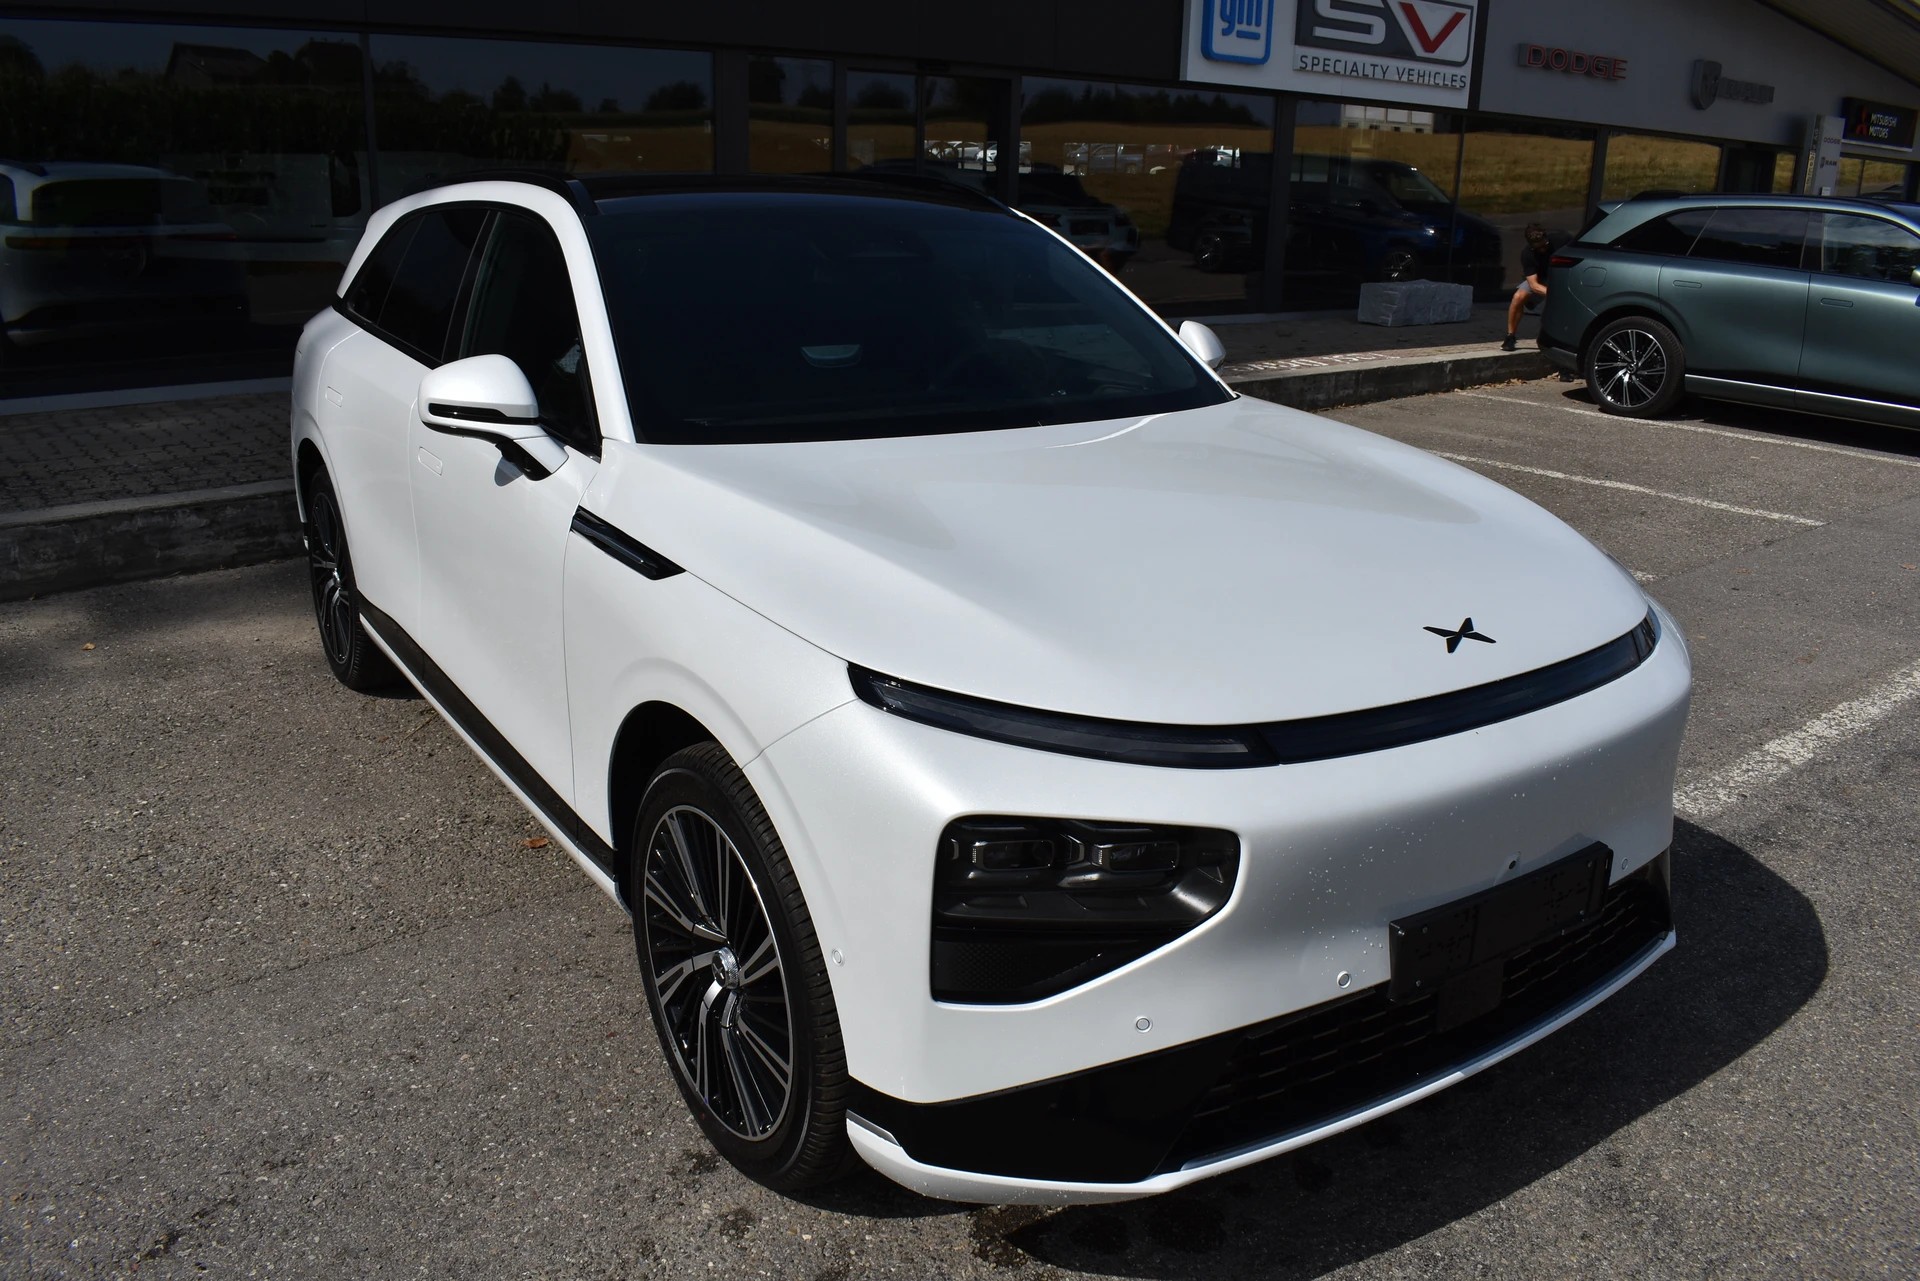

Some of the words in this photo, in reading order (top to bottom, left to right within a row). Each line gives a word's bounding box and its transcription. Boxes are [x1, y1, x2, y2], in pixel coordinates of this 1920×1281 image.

[1299, 54, 1390, 80] SPECIALTY
[1396, 66, 1468, 89] VEHICLES
[1526, 44, 1628, 80] DODGE
